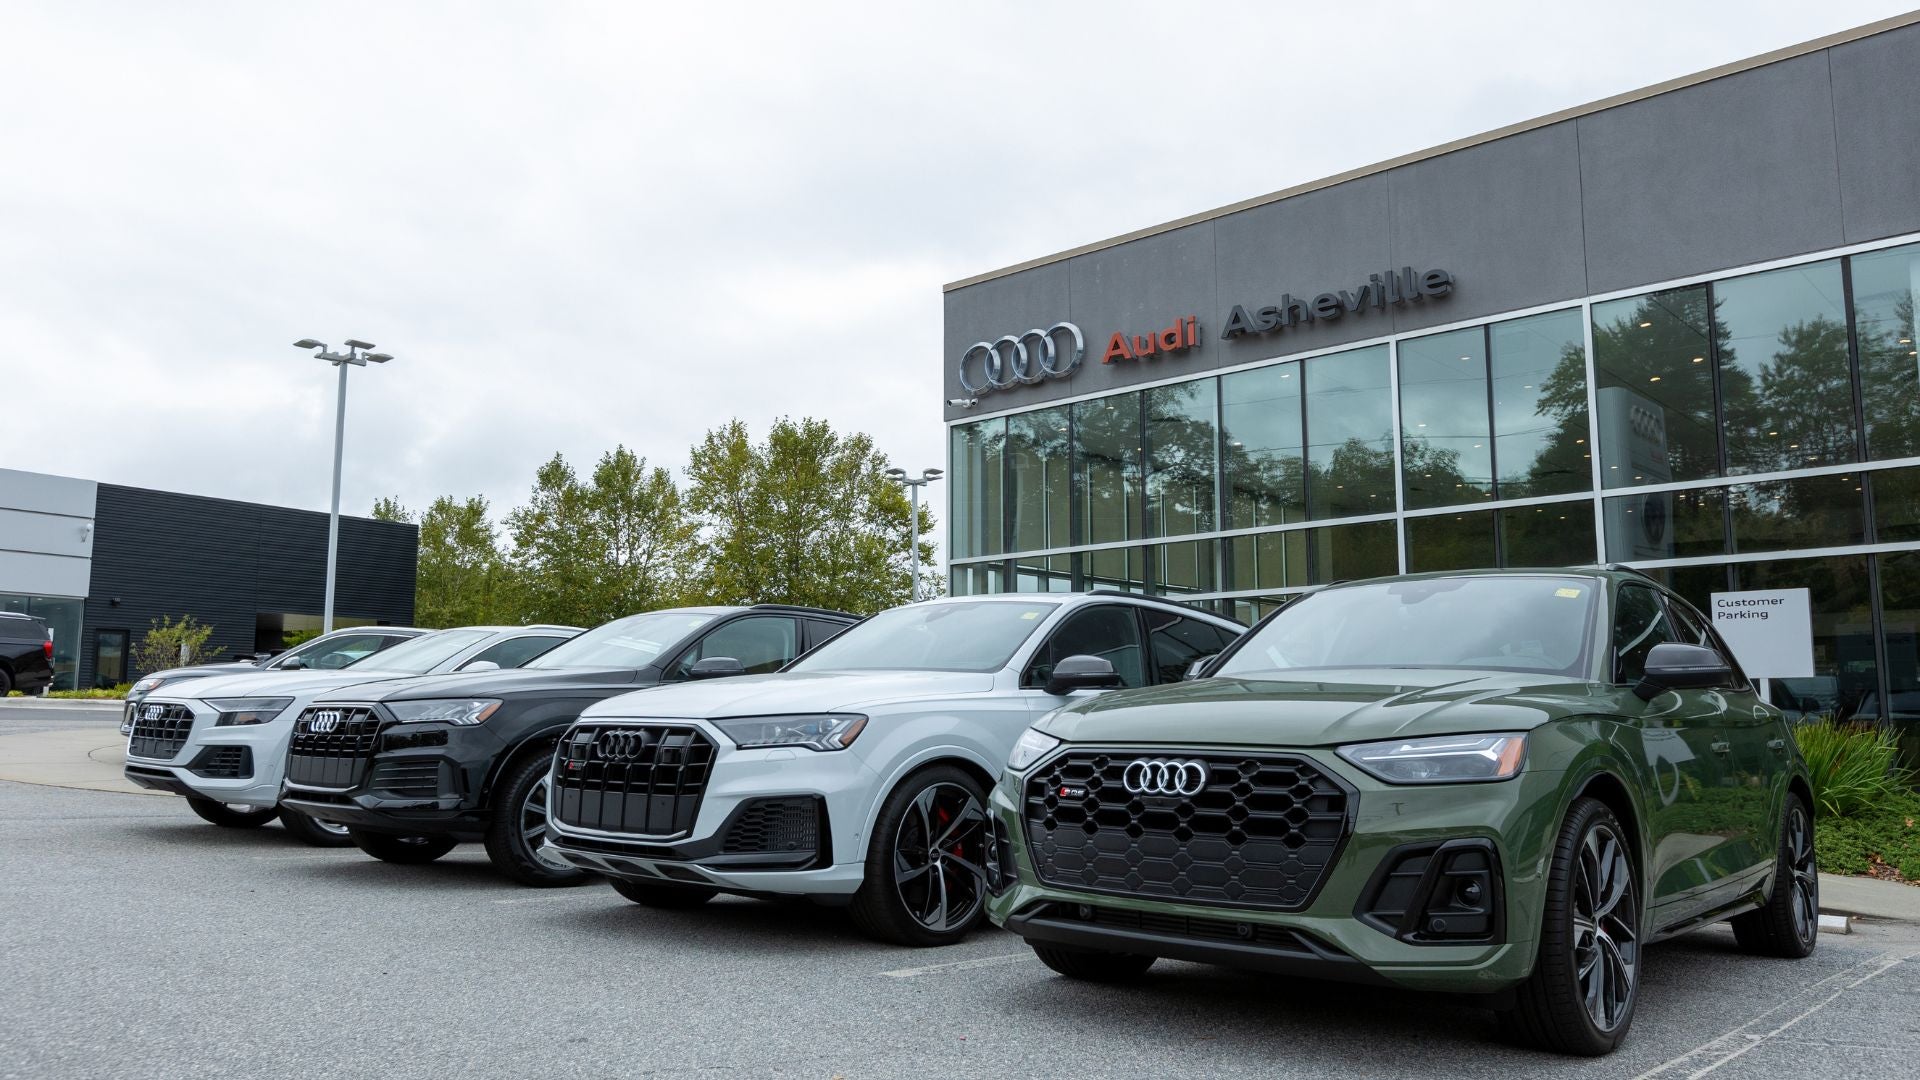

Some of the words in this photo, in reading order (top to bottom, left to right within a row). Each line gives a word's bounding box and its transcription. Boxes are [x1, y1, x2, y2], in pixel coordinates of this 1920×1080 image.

[1102, 315, 1198, 364] Audi
[1221, 265, 1454, 340] Asheville
[1717, 598, 1785, 608] Customer
[1717, 610, 1769, 620] Parking
